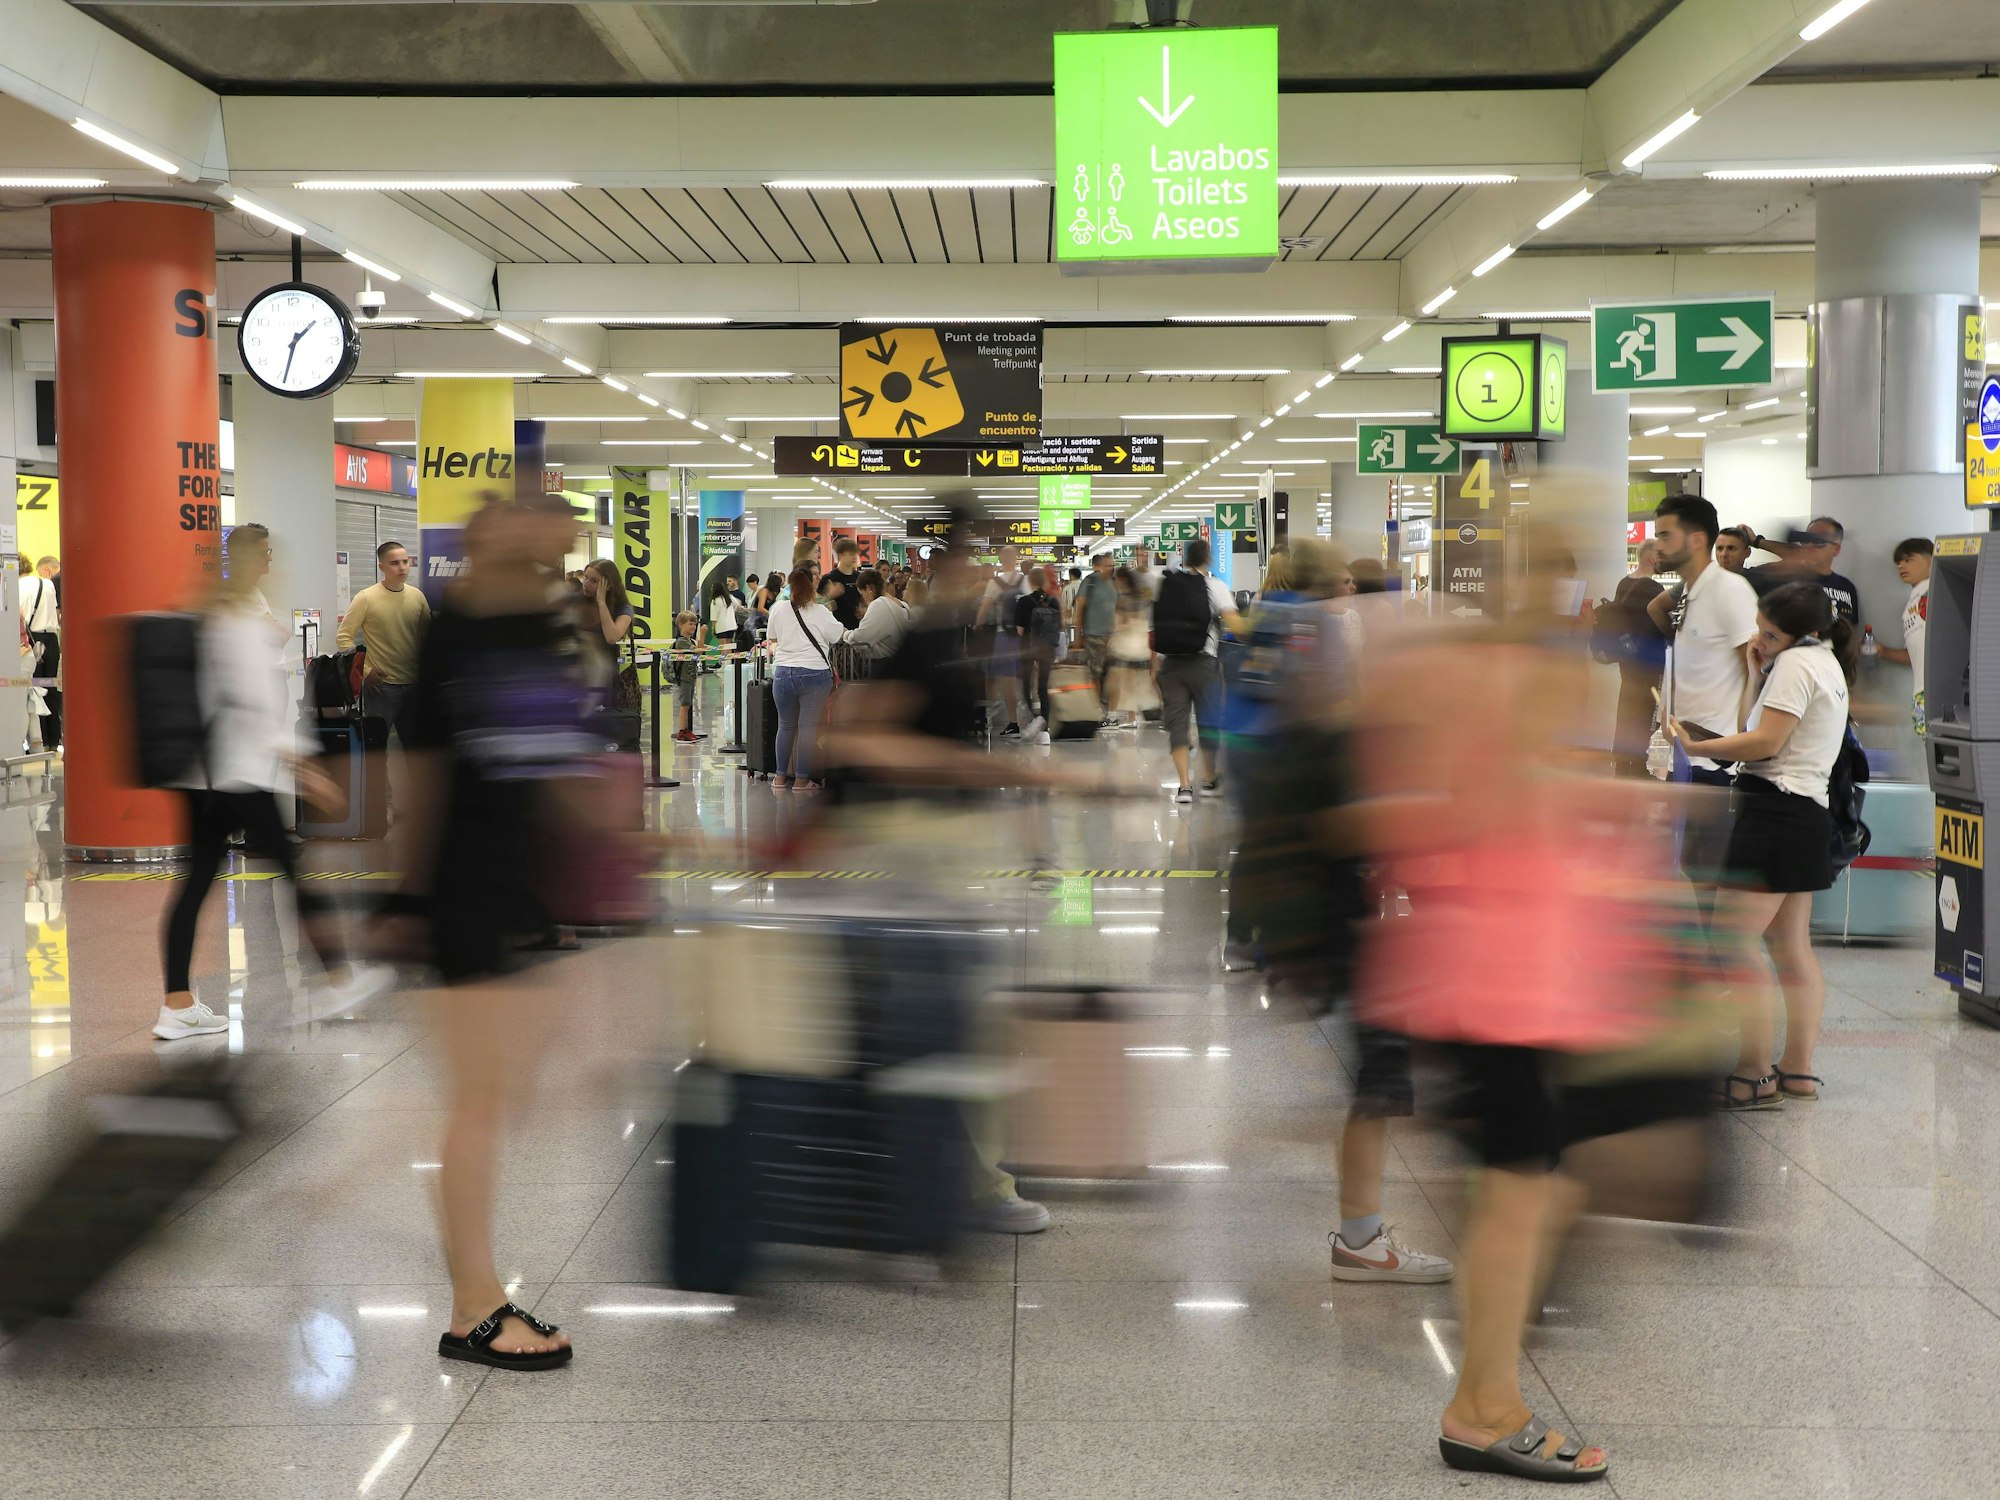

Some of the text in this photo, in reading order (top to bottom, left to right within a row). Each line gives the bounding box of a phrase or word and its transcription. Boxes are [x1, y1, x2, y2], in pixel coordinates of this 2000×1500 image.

[1151, 143, 1269, 172] Lavabos
[1152, 177, 1248, 206] Toilets
[1152, 211, 1240, 239] Aseos
[288, 298, 300, 307] 12
[944, 332, 1037, 342] Punt de trobada
[977, 345, 1037, 357] Meeting point
[993, 358, 1037, 370] Treffpunkt
[985, 412, 1037, 422] Punto de
[979, 426, 1037, 435] encuentro
[1071, 438, 1101, 446] sortides
[1131, 437, 1158, 445] Sortida
[1062, 447, 1094, 455] departures
[1131, 446, 1142, 454] Exit
[177, 441, 216, 470] THE
[861, 456, 883, 464] Ankunft
[904, 449, 921, 468] C
[1022, 455, 1056, 464] Abfertigung
[1069, 455, 1088, 464] Abflug
[1131, 455, 1156, 464] Ausgang
[422, 446, 512, 479] Hertz
[346, 454, 368, 485] AVIS
[861, 464, 891, 472] Llegadas
[1022, 464, 1067, 472] Facturación
[1076, 464, 1103, 472] salidas
[1131, 464, 1155, 472] Salida
[1970, 458, 1984, 478] 24
[178, 474, 214, 498] FOR
[1459, 458, 1496, 509] 4
[707, 520, 731, 528] Alamo
[700, 533, 741, 542] enterprise
[709, 546, 737, 554] National
[1452, 567, 1482, 578] ATM
[1450, 582, 1485, 593] HERE
[1940, 814, 1978, 860] ATM
